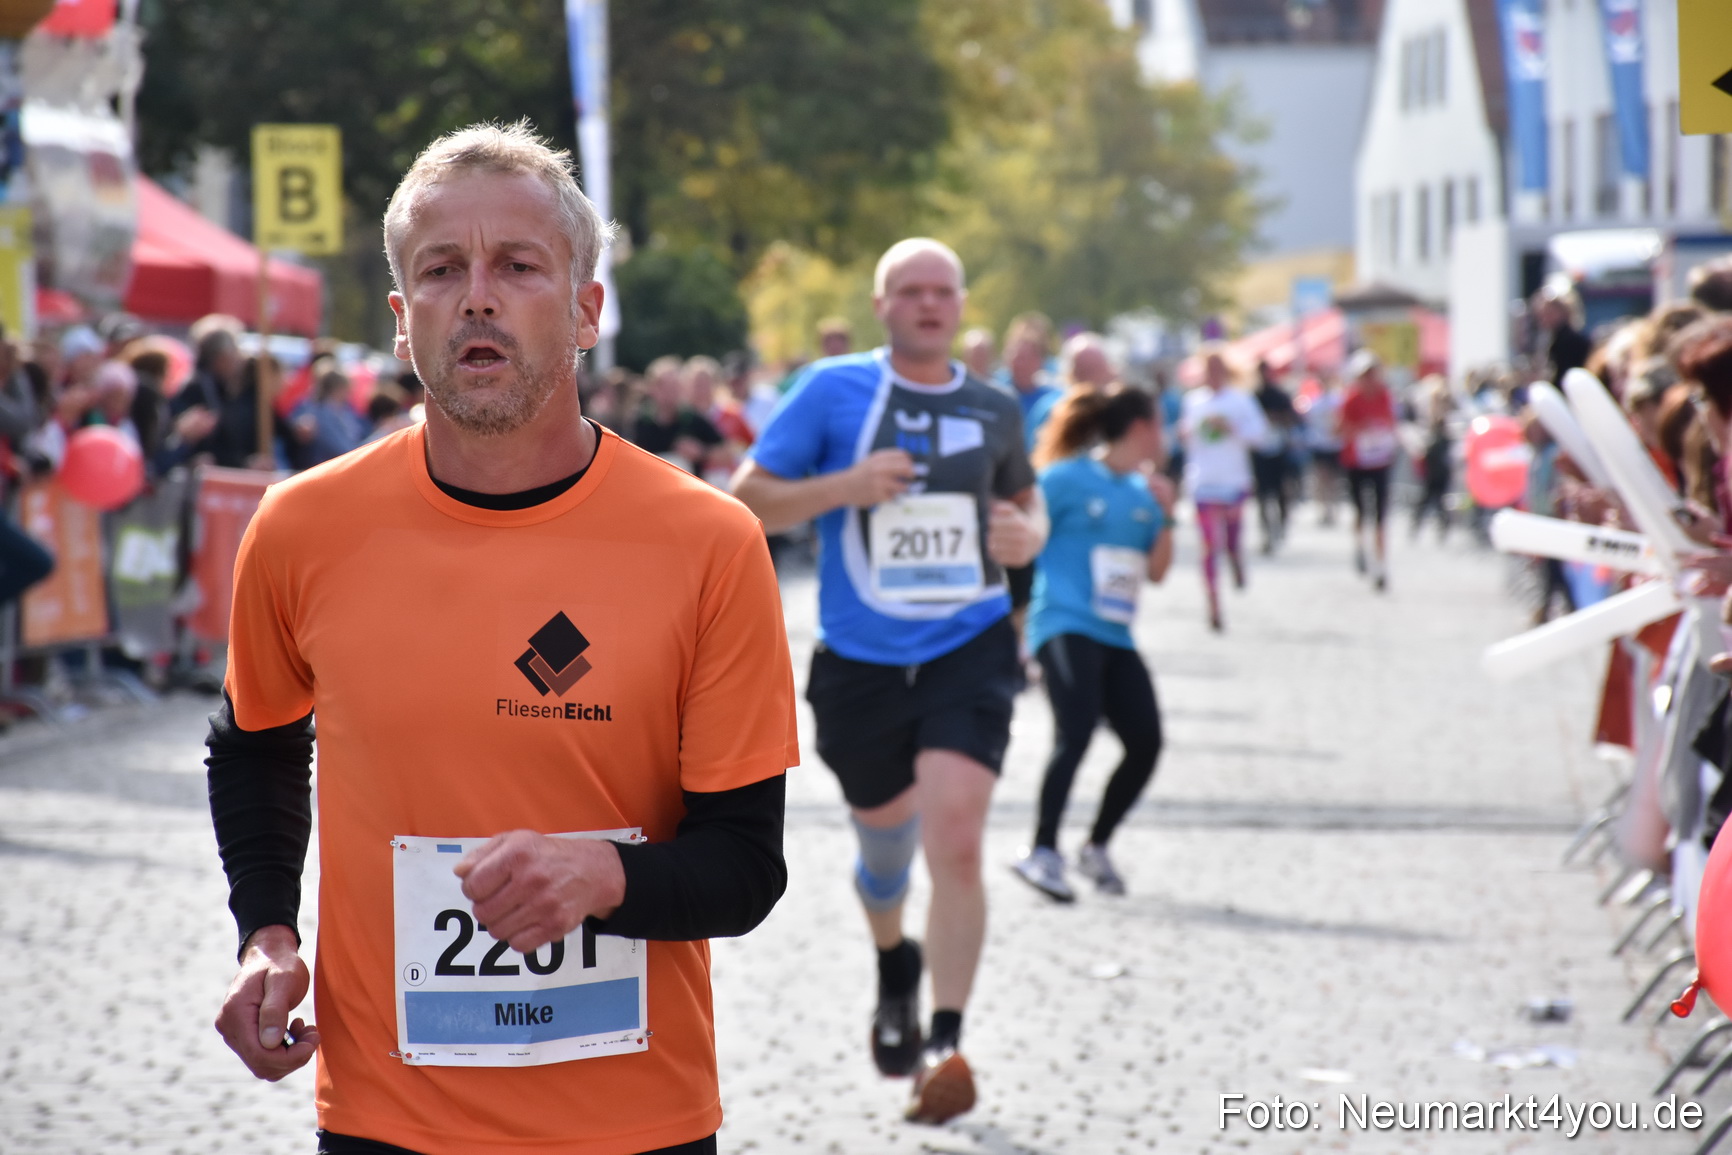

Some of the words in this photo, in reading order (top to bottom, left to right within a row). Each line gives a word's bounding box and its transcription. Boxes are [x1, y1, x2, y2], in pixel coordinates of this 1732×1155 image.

[279, 166, 320, 224] B
[888, 526, 964, 561] 2017
[496, 698, 613, 722] FliesenEichl
[410, 967, 420, 981] D
[494, 1002, 554, 1027] Mike
